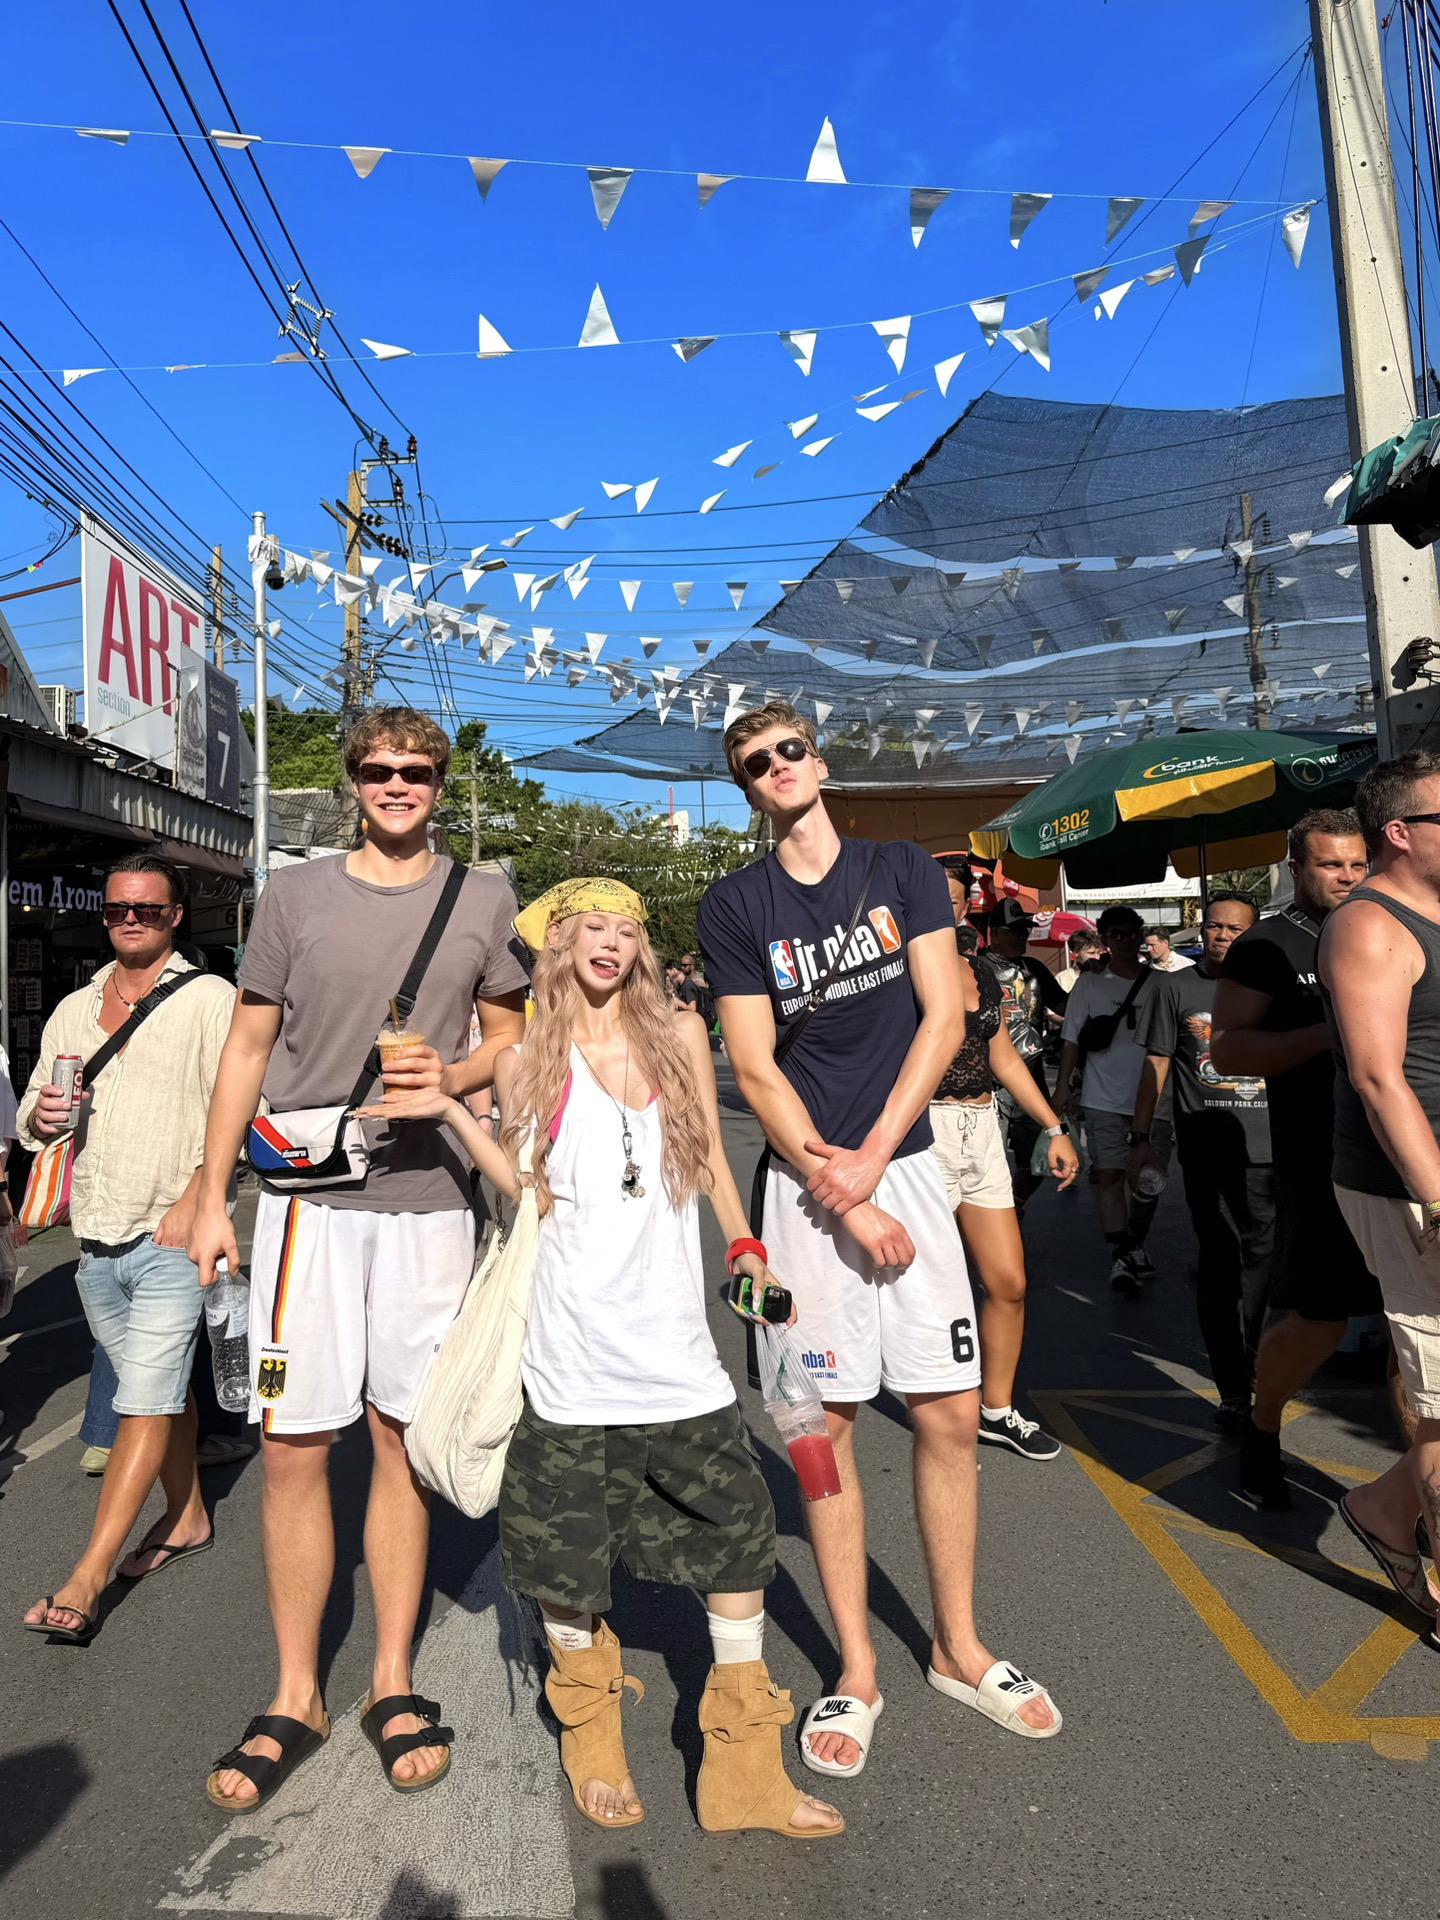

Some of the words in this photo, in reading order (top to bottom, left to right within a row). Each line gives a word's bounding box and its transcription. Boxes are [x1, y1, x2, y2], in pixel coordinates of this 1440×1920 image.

[98, 555, 199, 716] ART
[97, 686, 131, 718] section
[217, 730, 231, 789] 7
[1051, 808, 1090, 835] 1302
[793, 924, 882, 993] jr.nba
[825, 977, 861, 1002] MIDDLE
[858, 969, 882, 991] EAST
[879, 958, 906, 984] FINALS
[261, 1345, 290, 1355] Deutschland
[950, 1316, 976, 1364] 6
[801, 1350, 826, 1369] nba
[820, 1699, 853, 1713] NIKE
